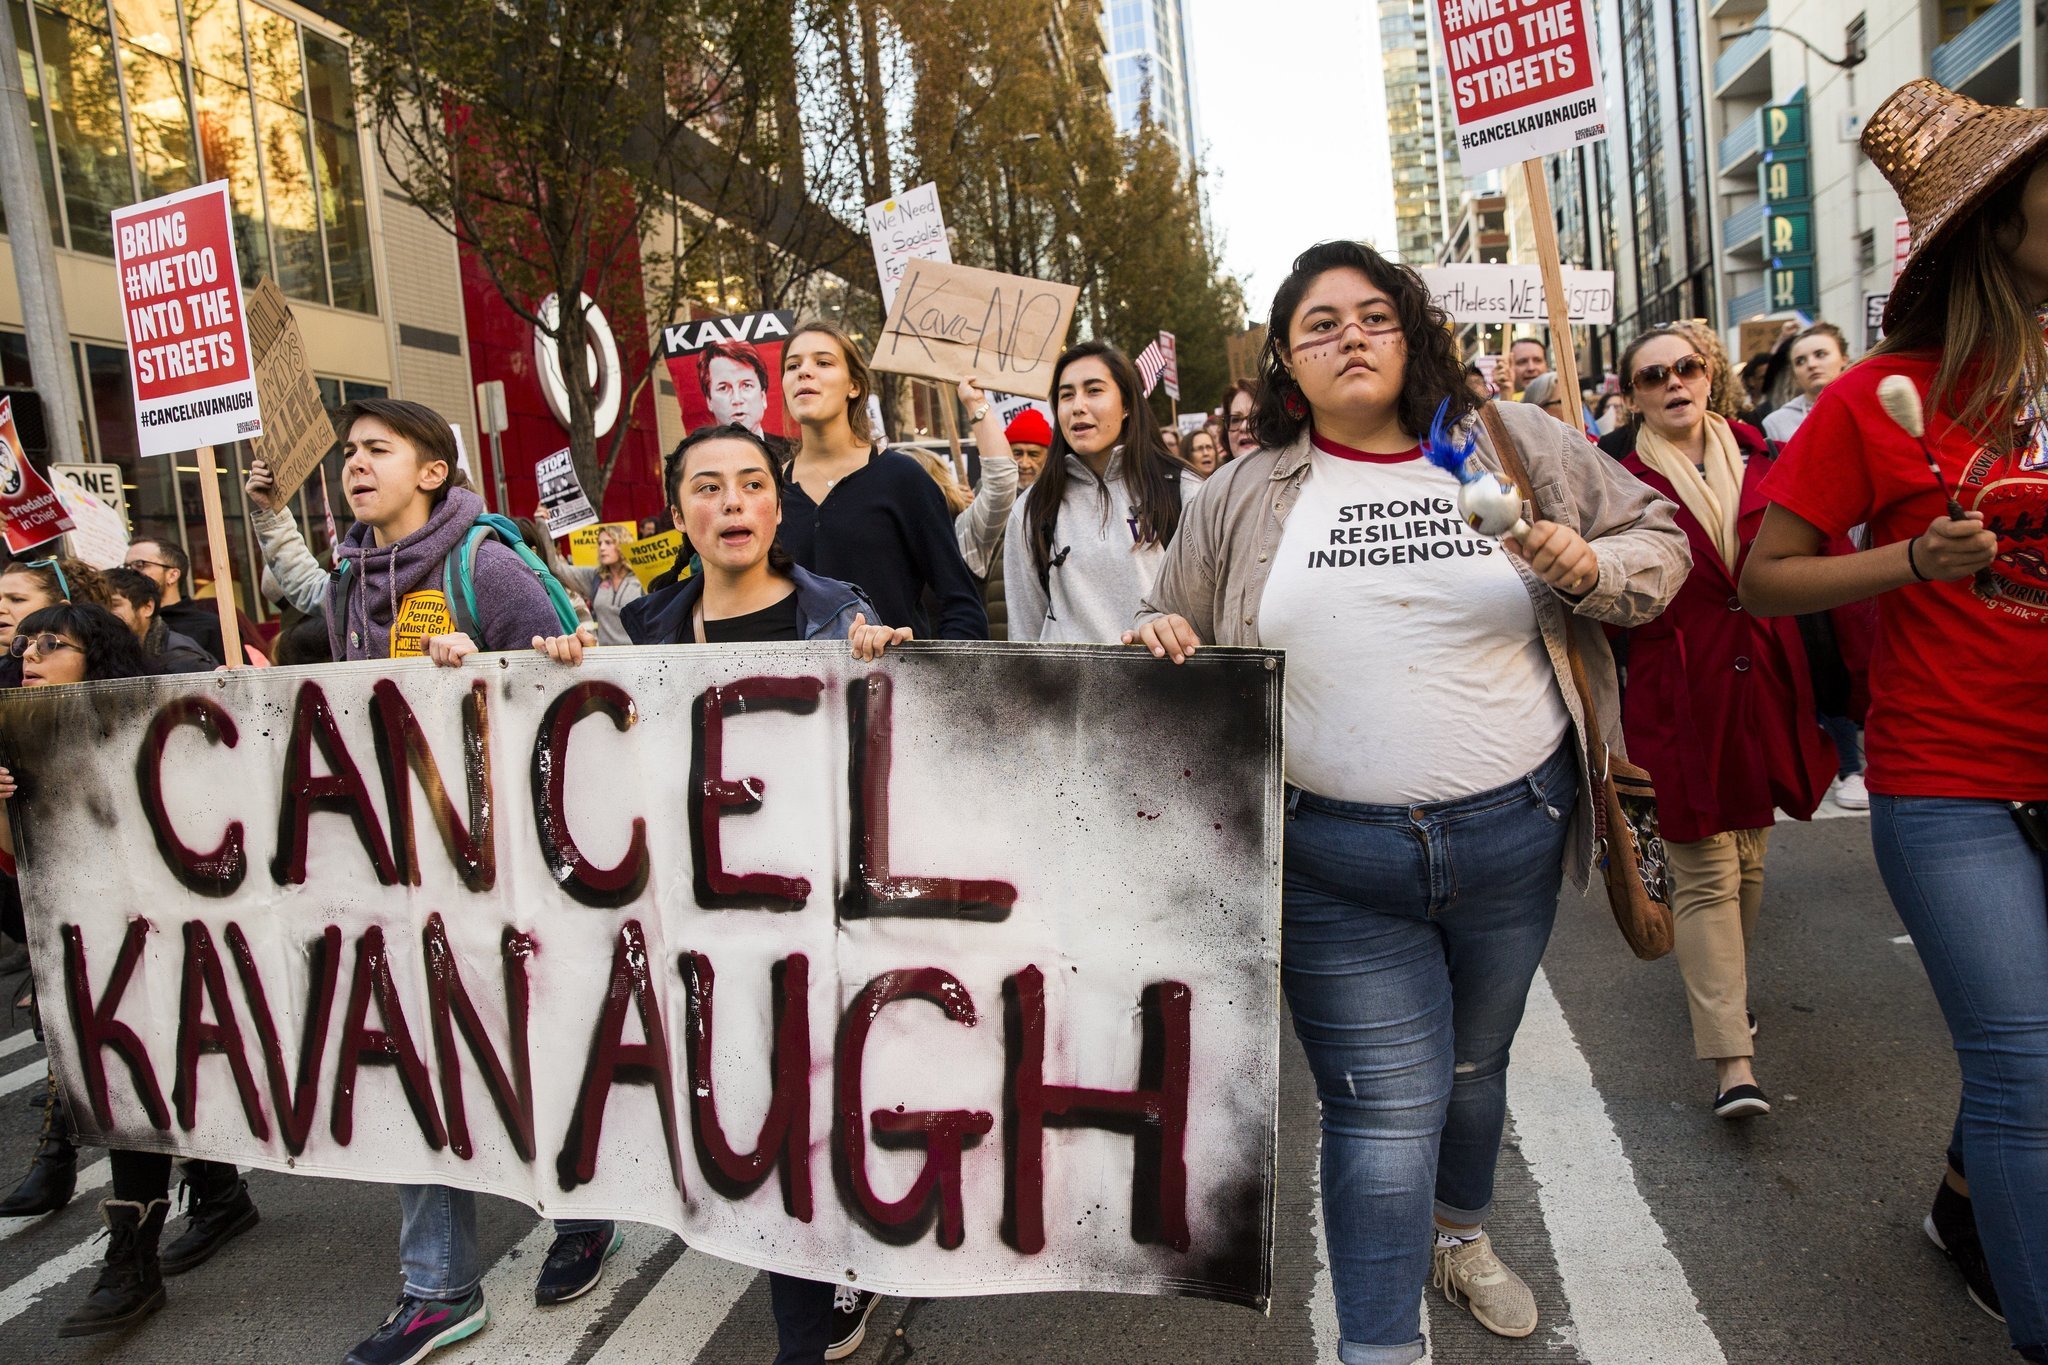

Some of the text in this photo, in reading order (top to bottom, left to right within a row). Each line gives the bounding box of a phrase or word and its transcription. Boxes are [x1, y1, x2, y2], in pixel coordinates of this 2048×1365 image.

[1450, 1, 1575, 71] INTO THE
[1456, 44, 1576, 109] STREETS
[1461, 97, 1597, 150] #CANCELKAVANAUGH
[872, 190, 936, 232] We Need
[1768, 108, 1794, 305] PARK
[120, 211, 187, 260] BRING
[881, 219, 942, 252] a Socialist
[126, 247, 218, 301] #METOO
[1509, 279, 1535, 314] WE
[131, 287, 233, 343] INTO THE
[665, 312, 789, 353] KAVA
[137, 331, 235, 384] STREETS
[140, 391, 253, 427] #CANCELKAVANAUGH
[537, 451, 570, 476] STOP!
[10, 493, 56, 519] Predator
[20, 518, 32, 531] in
[31, 507, 58, 526] Chief
[1338, 497, 1454, 523] STRONG
[631, 538, 670, 555] PROTECT
[1330, 518, 1464, 546] RESILIENT
[629, 553, 657, 565] HEALTH
[658, 545, 682, 559] CAR
[1308, 539, 1493, 569] INDIGENOUS
[405, 611, 444, 625] Pence
[408, 600, 447, 613] Trump/
[400, 622, 446, 635] Must Go!
[136, 671, 1017, 922] CANCEL
[60, 912, 1192, 1255] KAVANAUGH
